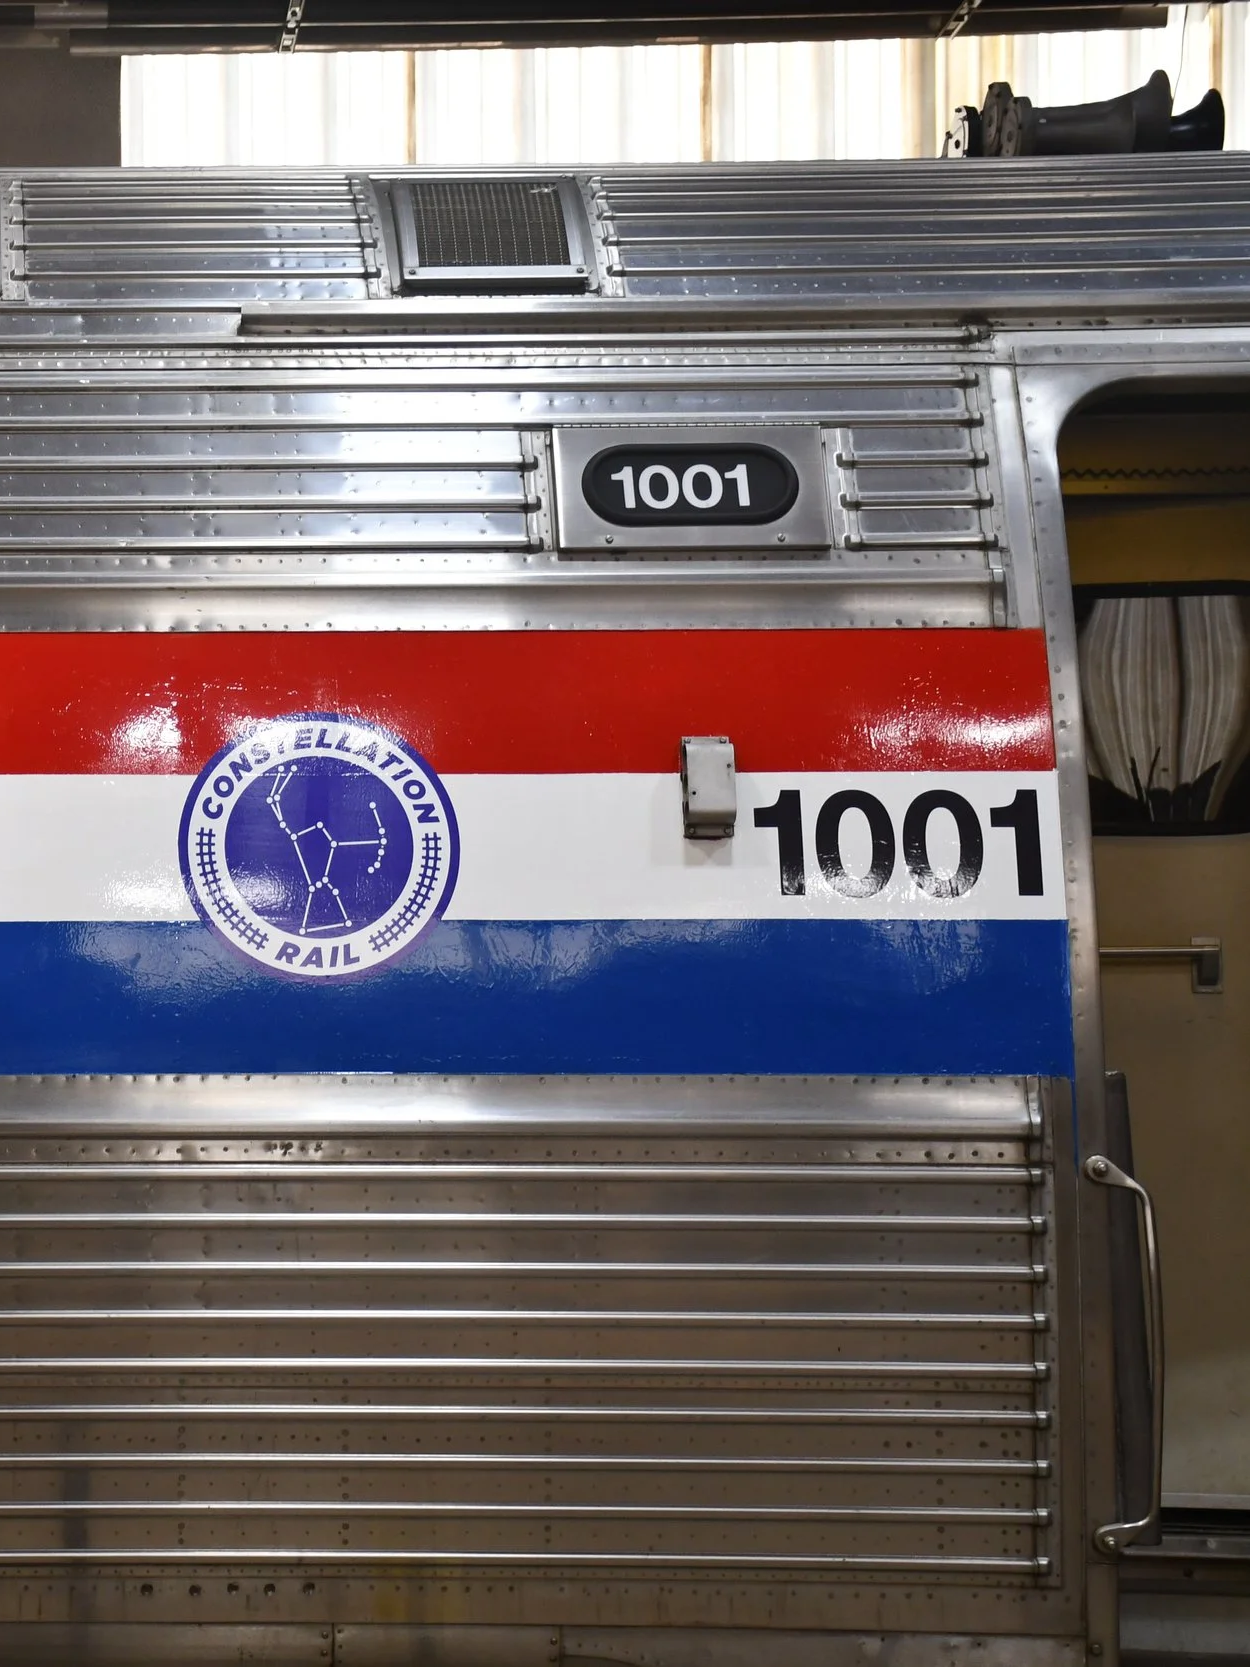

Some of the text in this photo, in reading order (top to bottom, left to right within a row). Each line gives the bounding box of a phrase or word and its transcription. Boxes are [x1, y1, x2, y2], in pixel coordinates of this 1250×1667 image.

[611, 464, 751, 509] 1001
[202, 728, 440, 823] CONSTELLATION
[753, 789, 1043, 898] 1001
[275, 943, 361, 969] RAIL
